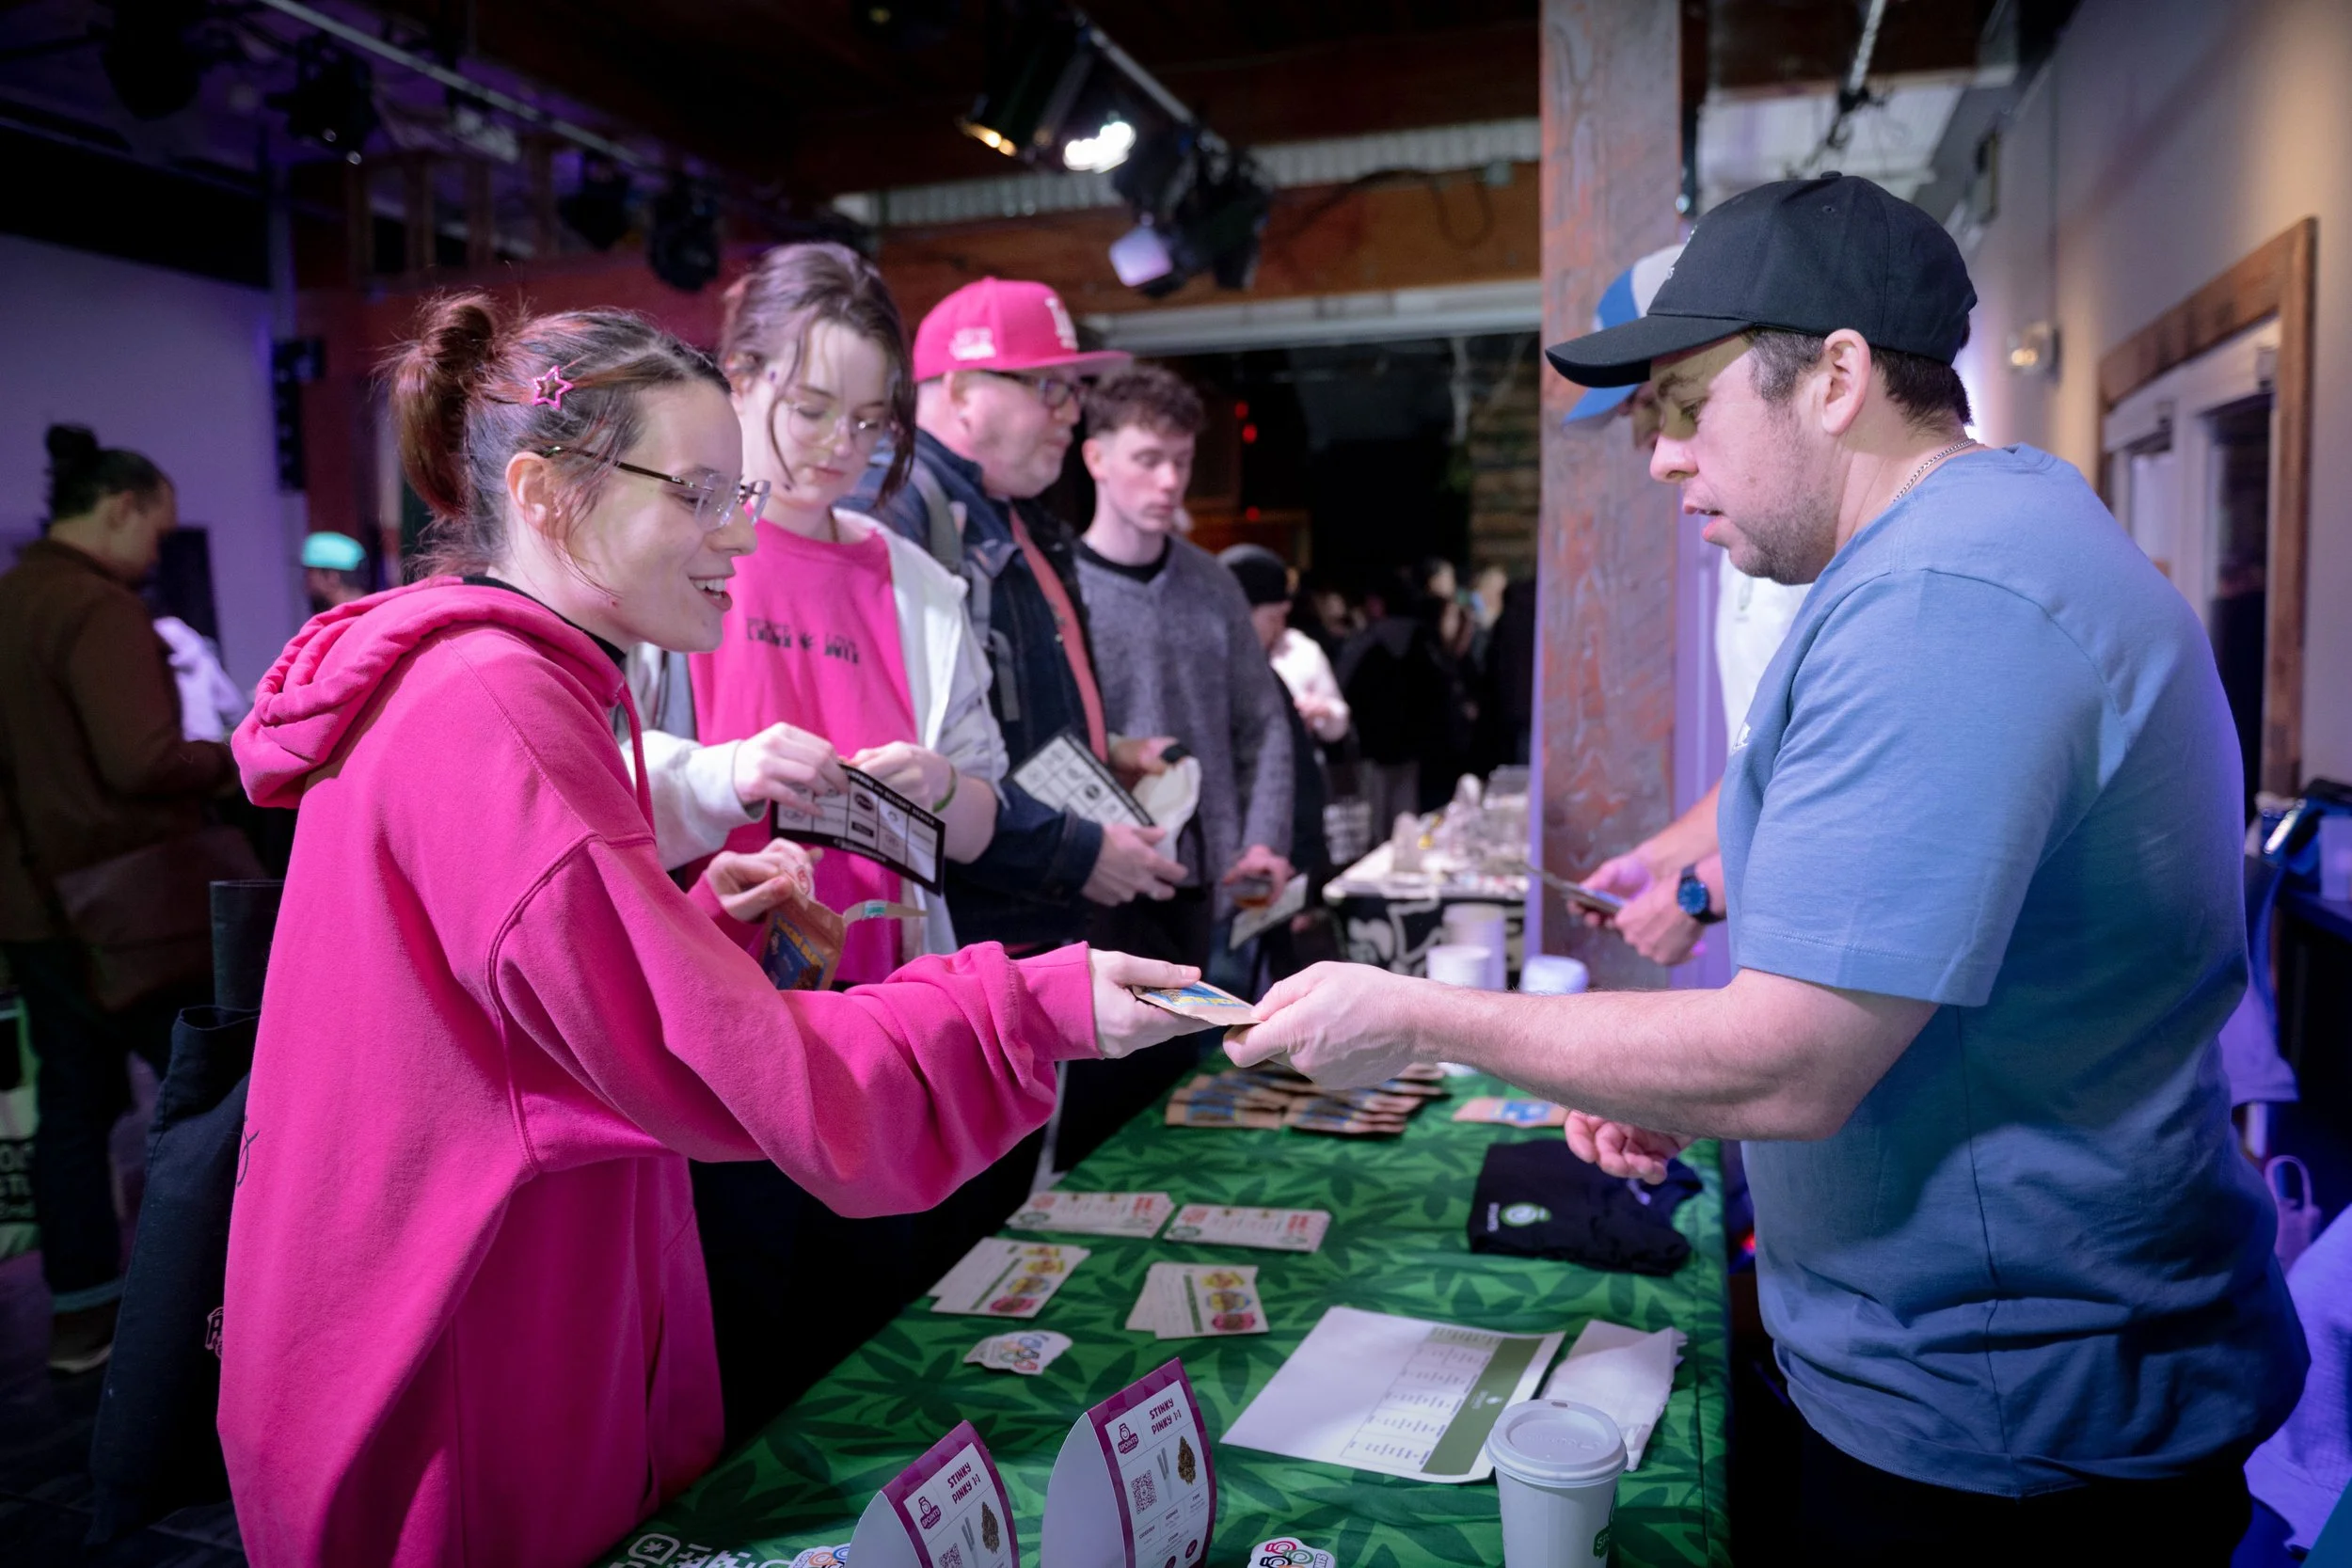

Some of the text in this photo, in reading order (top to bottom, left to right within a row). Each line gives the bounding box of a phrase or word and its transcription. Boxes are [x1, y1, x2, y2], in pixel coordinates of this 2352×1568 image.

[1150, 1398, 1174, 1419] STINKY
[1151, 1417, 1172, 1435] PINKY
[948, 1463, 971, 1487] STINKY
[952, 1481, 972, 1504] PINKY
